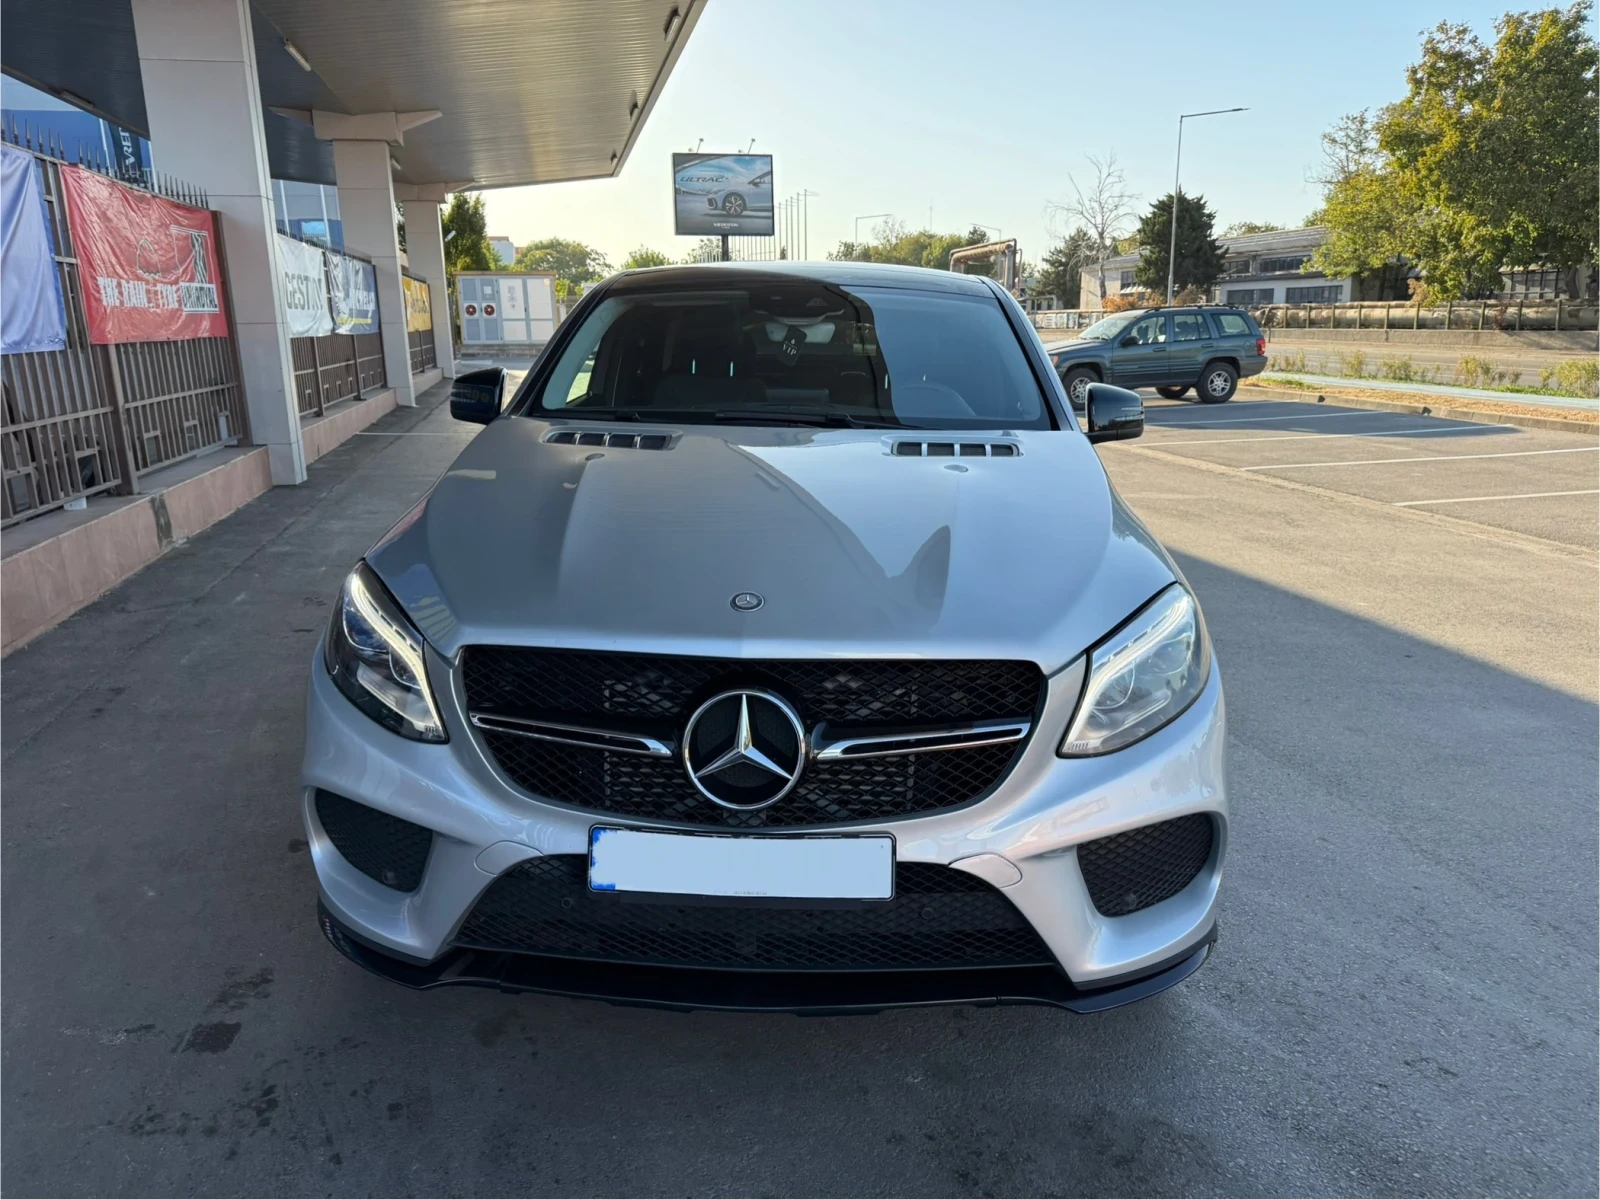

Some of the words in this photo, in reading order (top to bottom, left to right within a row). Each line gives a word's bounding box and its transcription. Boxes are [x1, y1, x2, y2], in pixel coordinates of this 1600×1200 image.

[97, 277, 119, 306] THE
[121, 280, 147, 307] RAIN
[157, 284, 178, 308] TYRE
[782, 343, 797, 355] VIP
